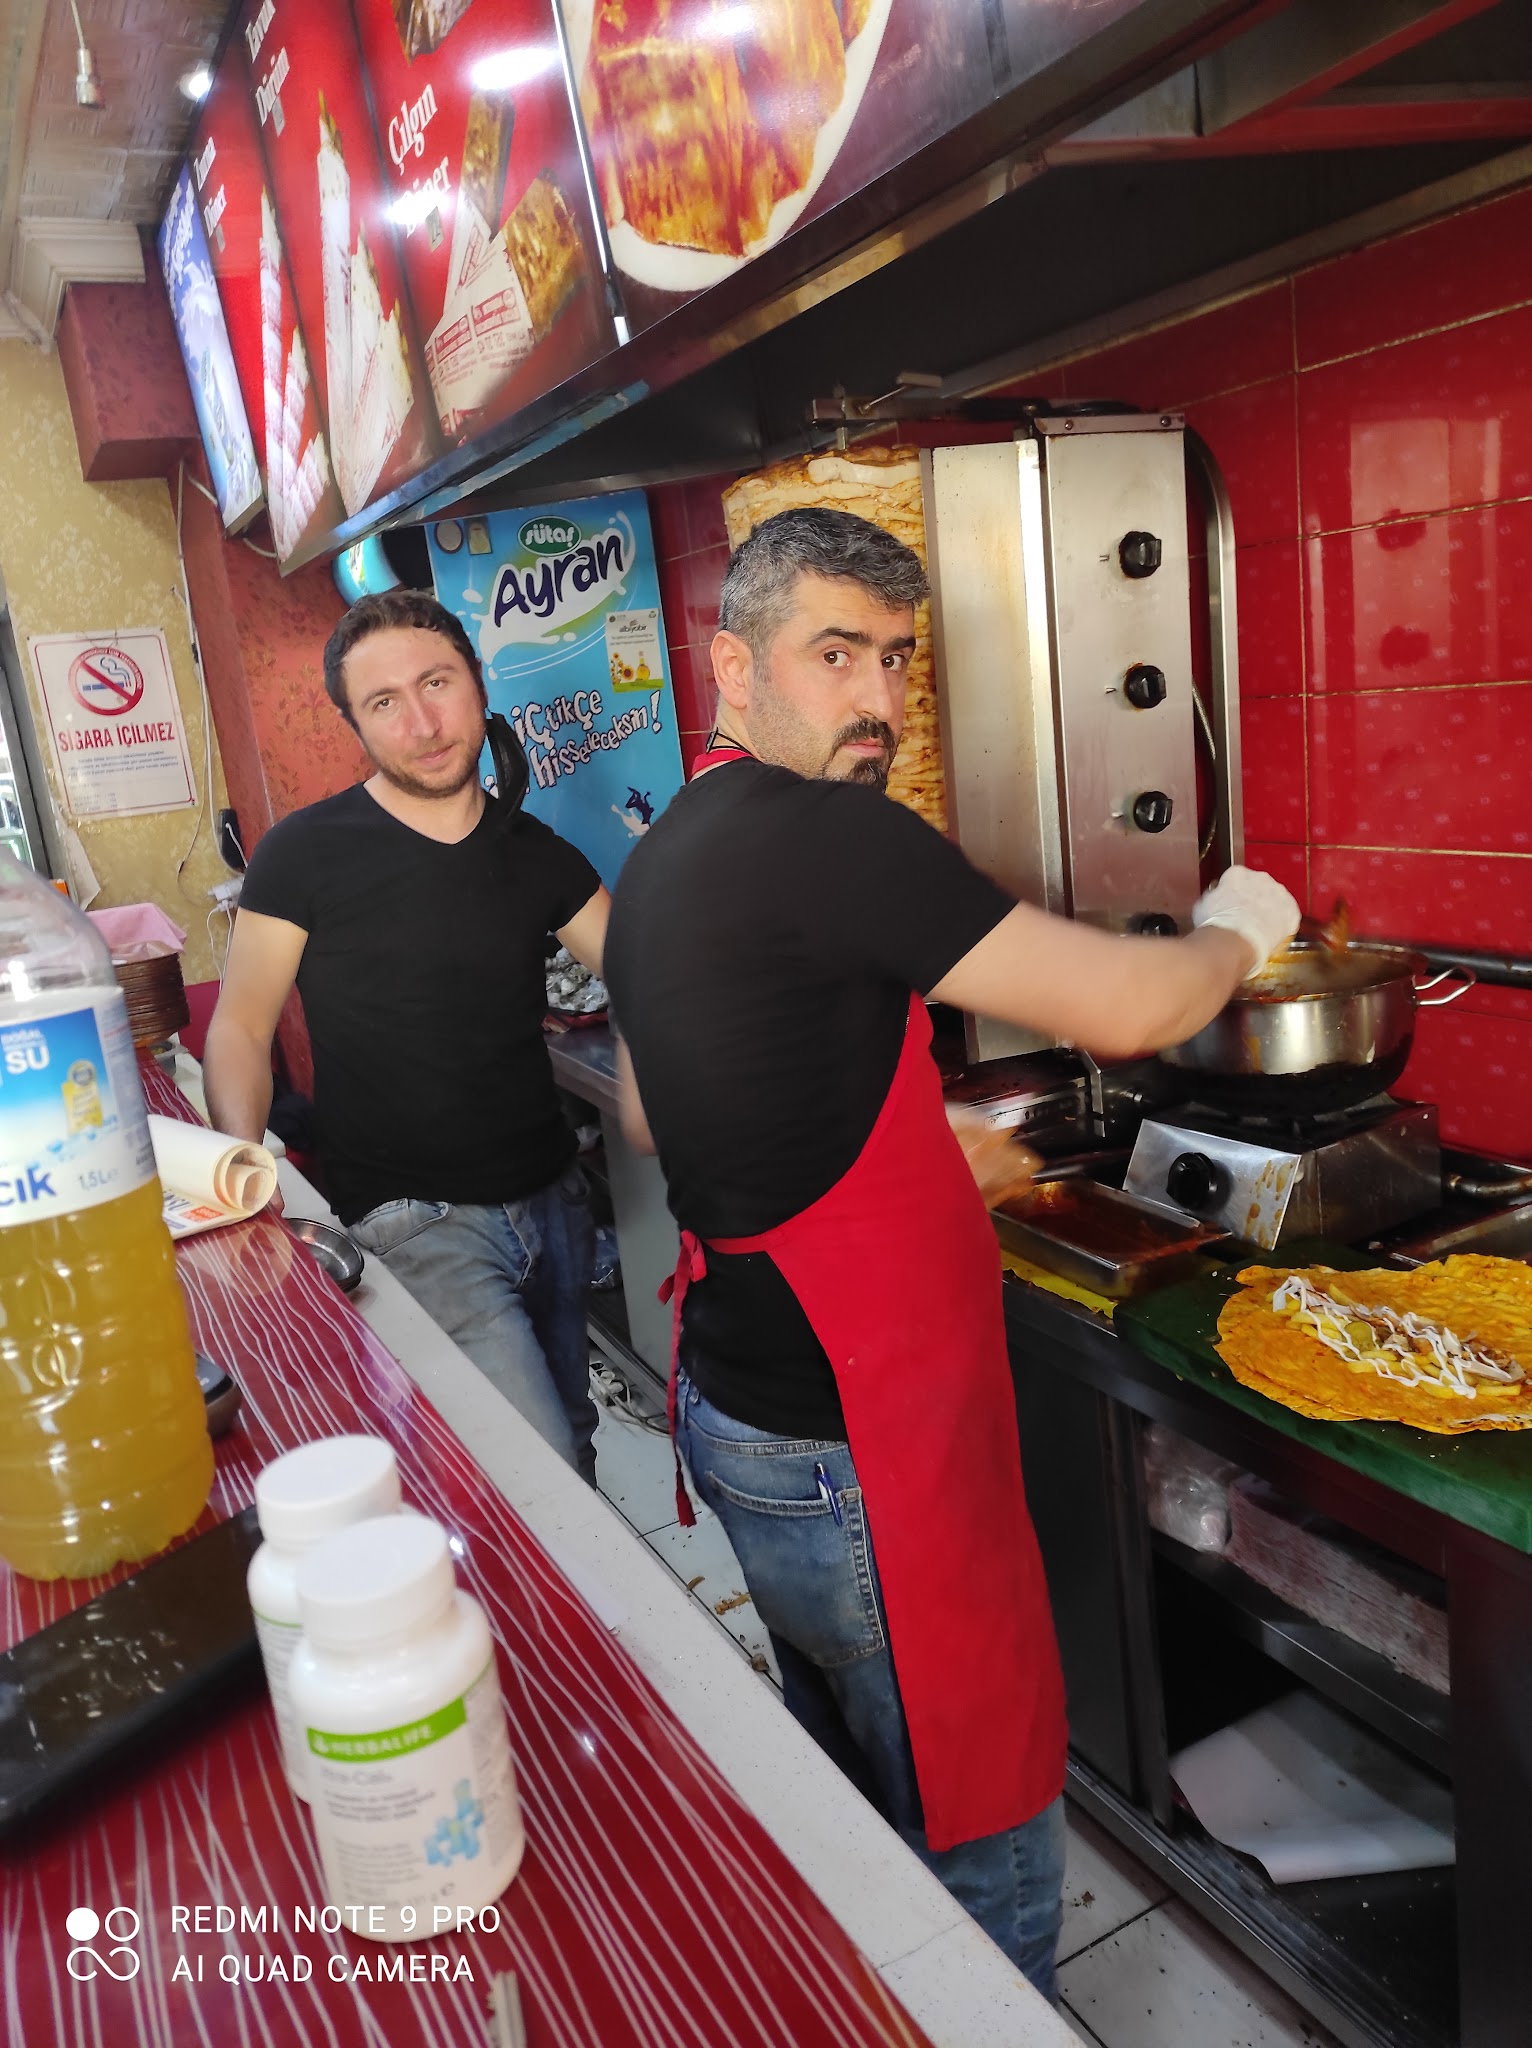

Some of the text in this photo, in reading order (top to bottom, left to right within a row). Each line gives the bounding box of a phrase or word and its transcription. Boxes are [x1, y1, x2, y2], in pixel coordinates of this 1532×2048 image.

[388, 83, 438, 176] Çılgın
[399, 156, 451, 238] ner
[525, 523, 575, 548] sütaş
[494, 535, 624, 628] Ayran
[116, 721, 175, 748] İÇİLMEZ
[5, 1046, 50, 1075] SU
